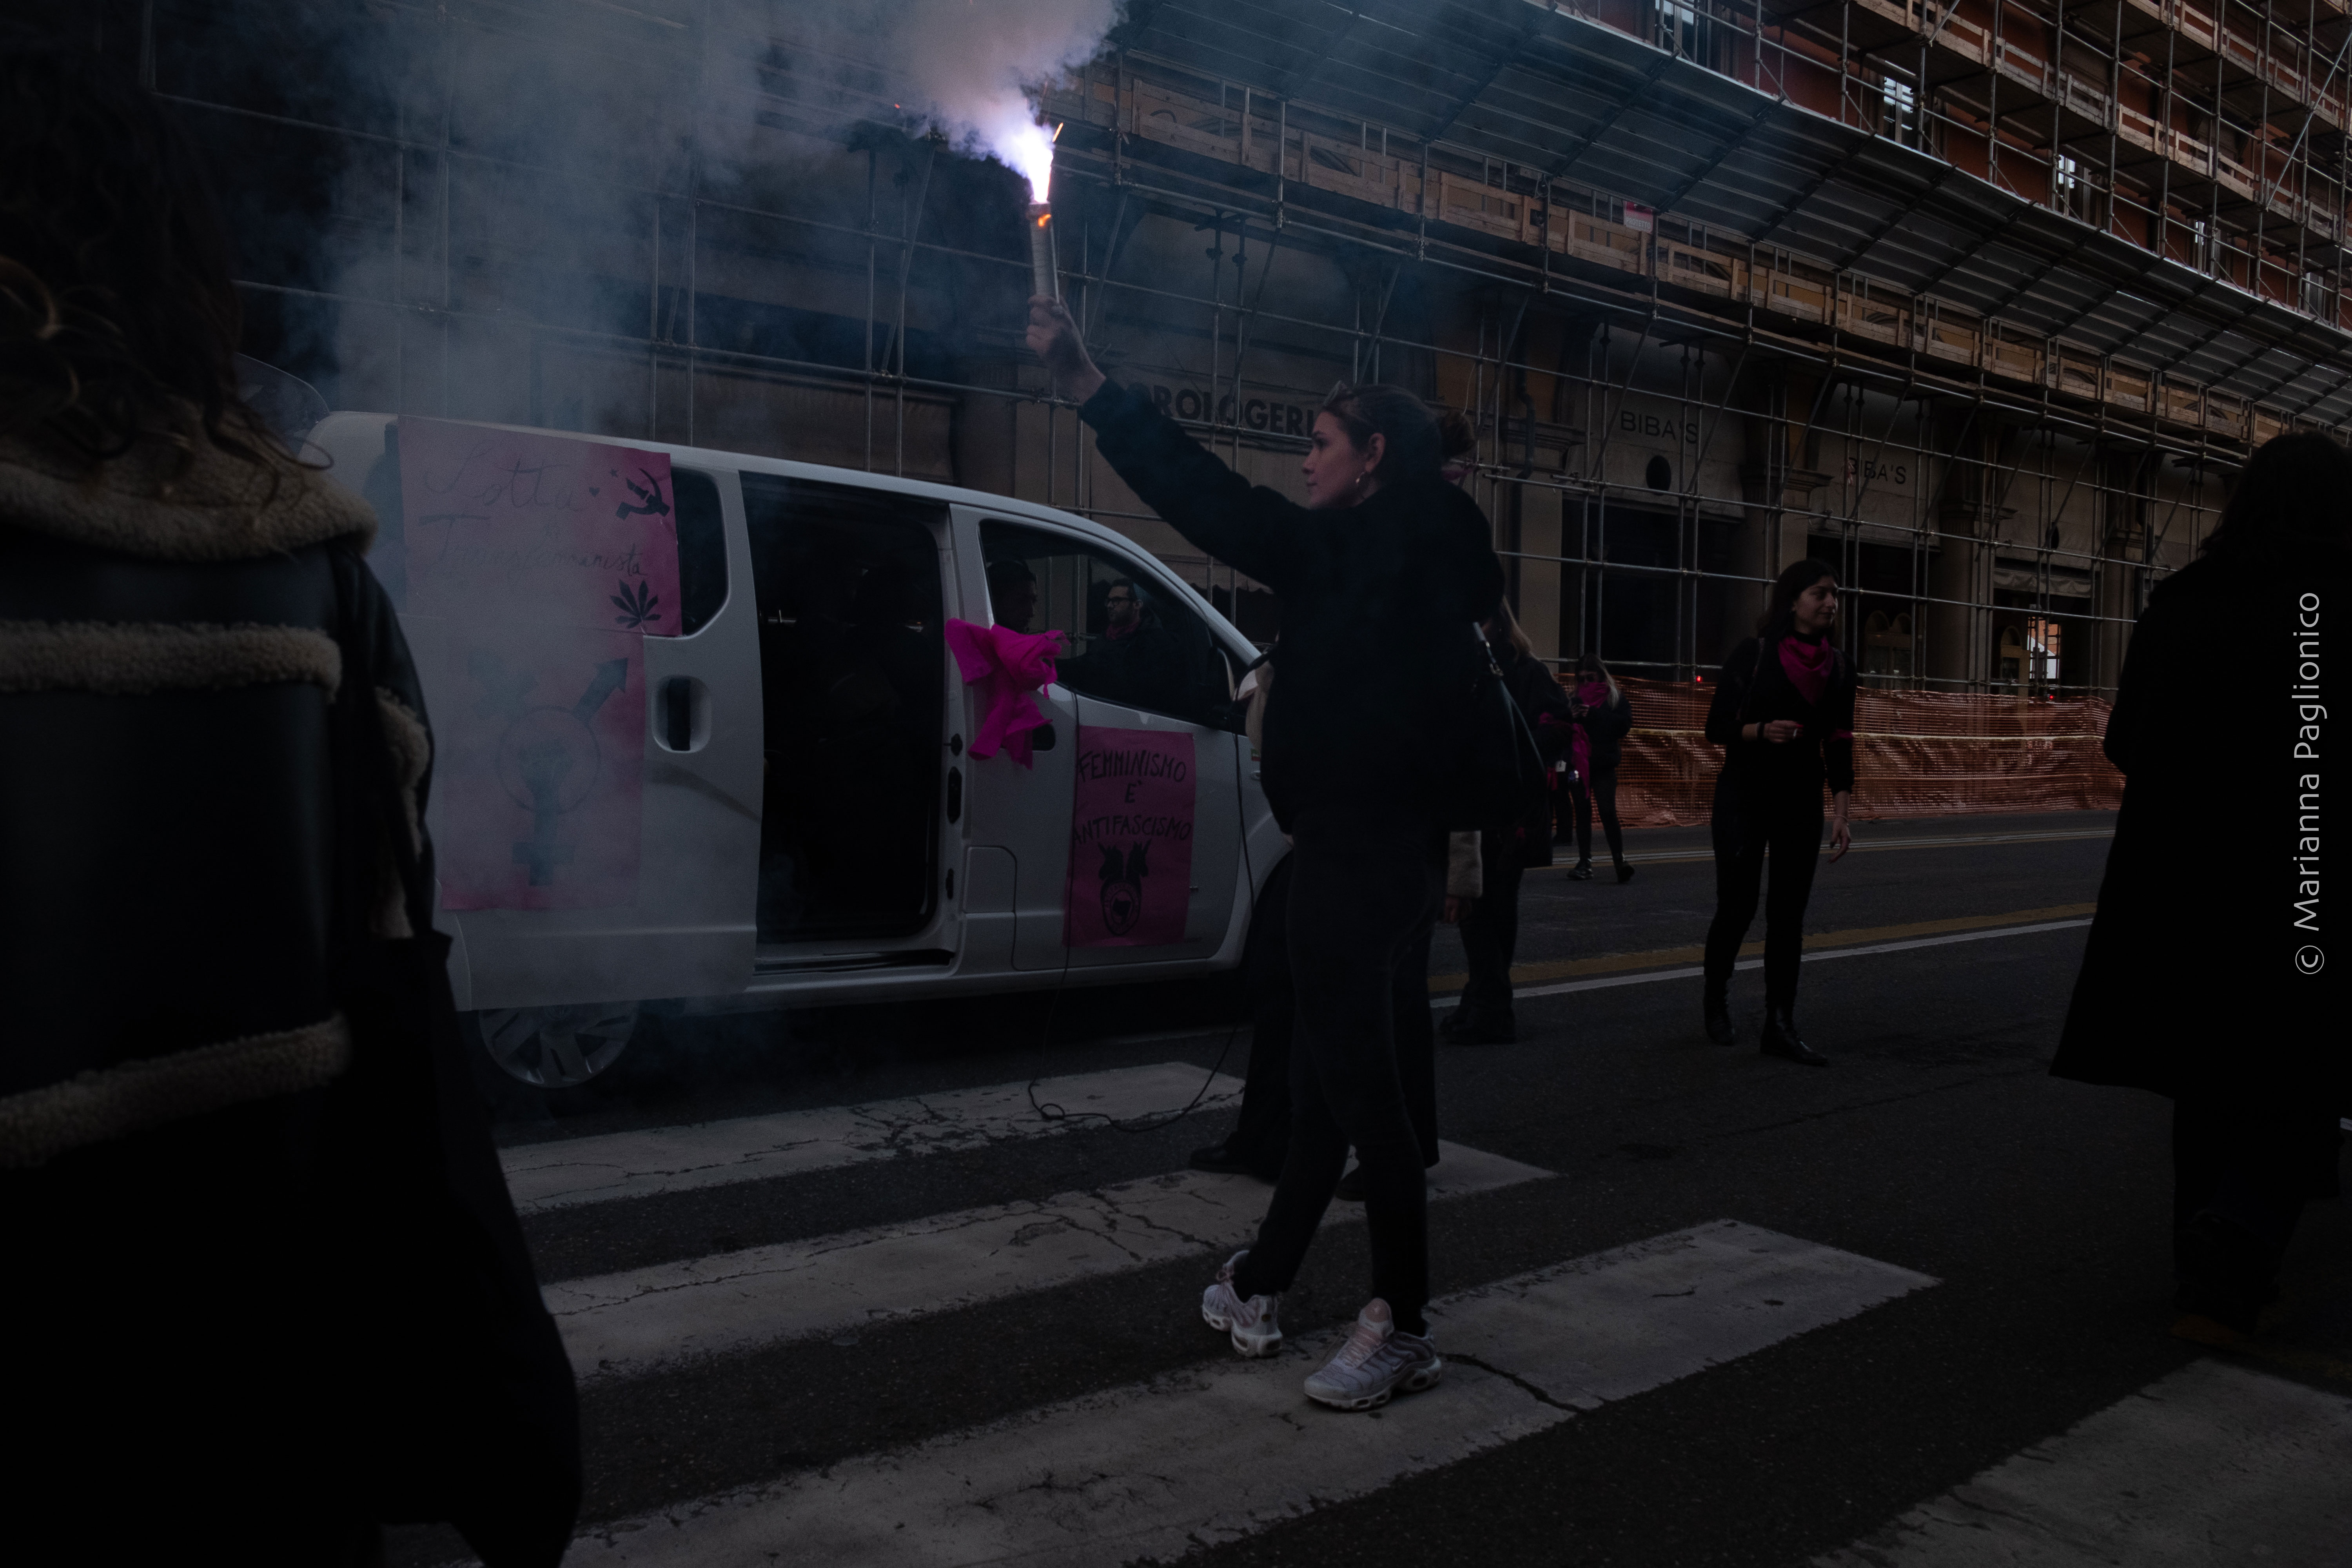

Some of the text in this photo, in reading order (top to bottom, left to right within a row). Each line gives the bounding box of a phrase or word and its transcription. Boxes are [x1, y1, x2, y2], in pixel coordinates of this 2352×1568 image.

[1626, 217, 1651, 229] PROTETTO
[1621, 410, 1698, 444] BIBA'S
[1078, 749, 1187, 783] FEMMINISMO
[1072, 815, 1191, 844] ANTIFASCISMO
